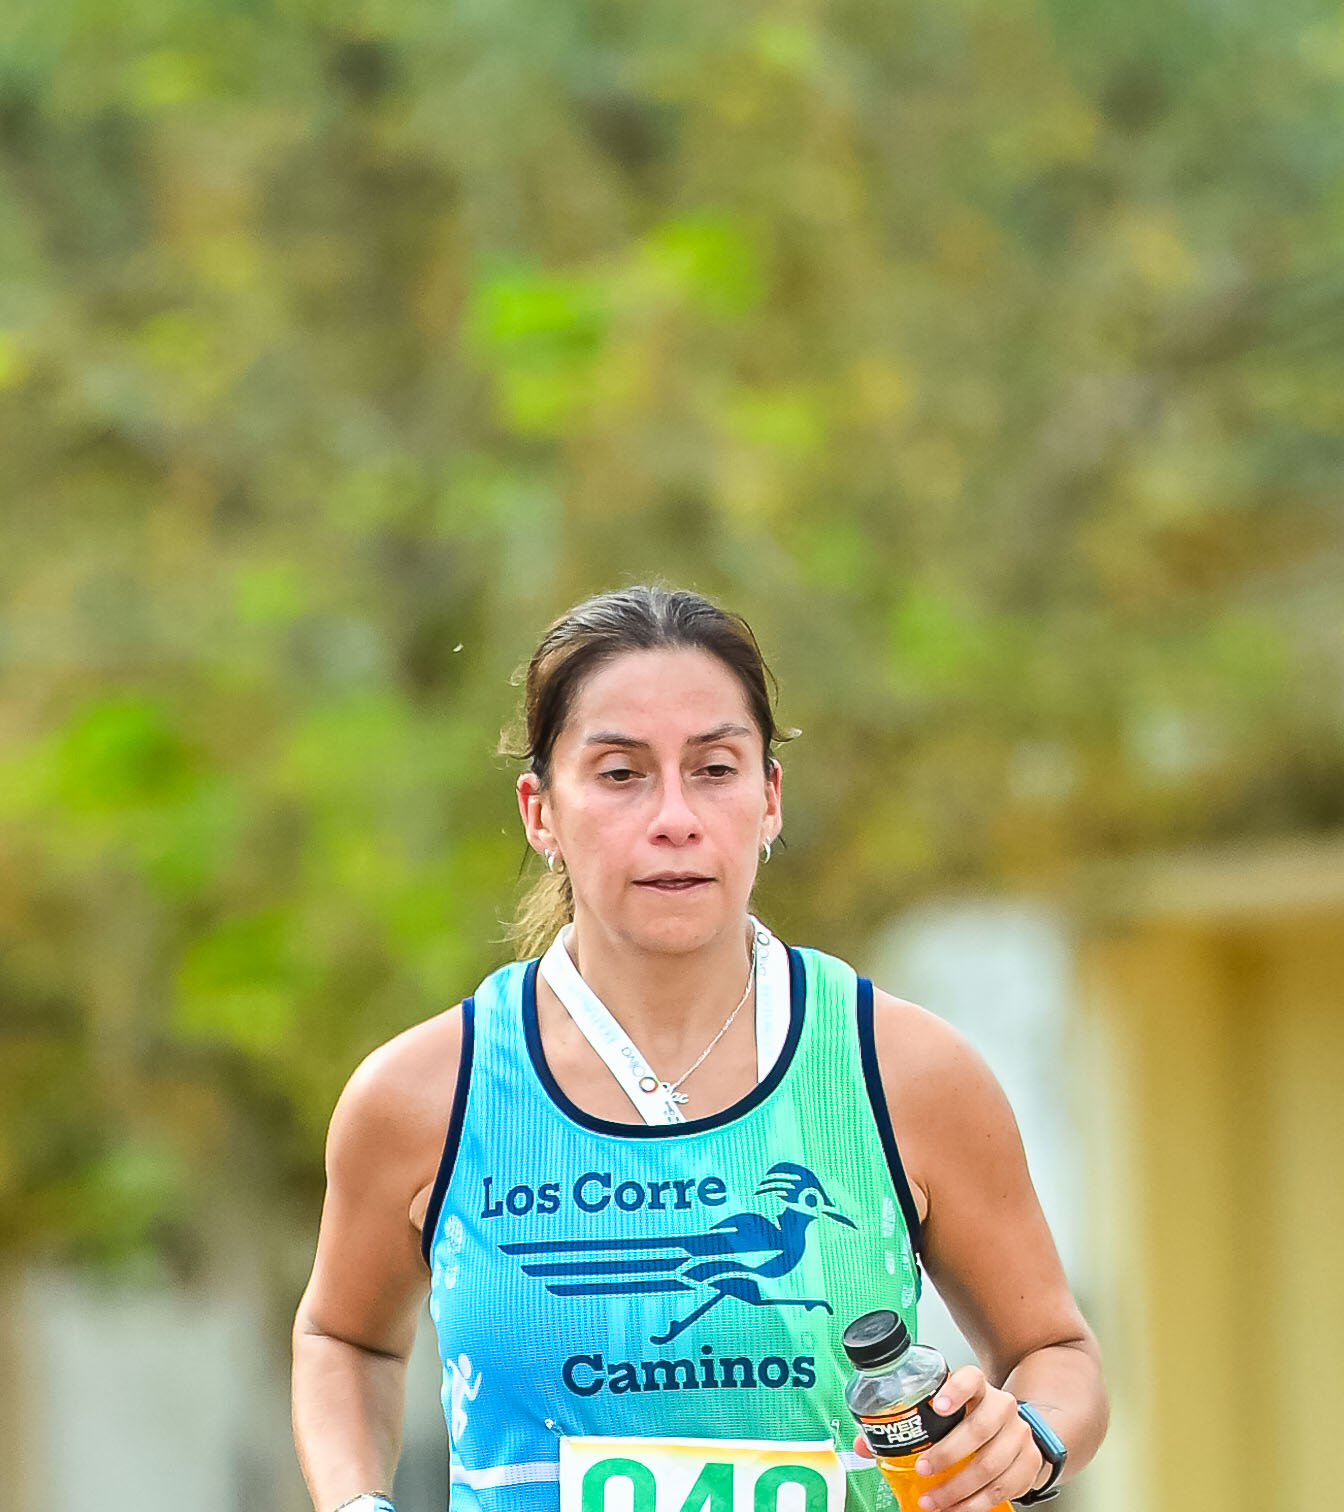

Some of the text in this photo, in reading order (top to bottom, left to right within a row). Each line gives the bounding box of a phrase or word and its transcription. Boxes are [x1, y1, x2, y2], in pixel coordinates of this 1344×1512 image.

[480, 1171, 727, 1219] Los Corre
[562, 1344, 816, 1397] Caminos
[862, 1414, 922, 1435] POWER
